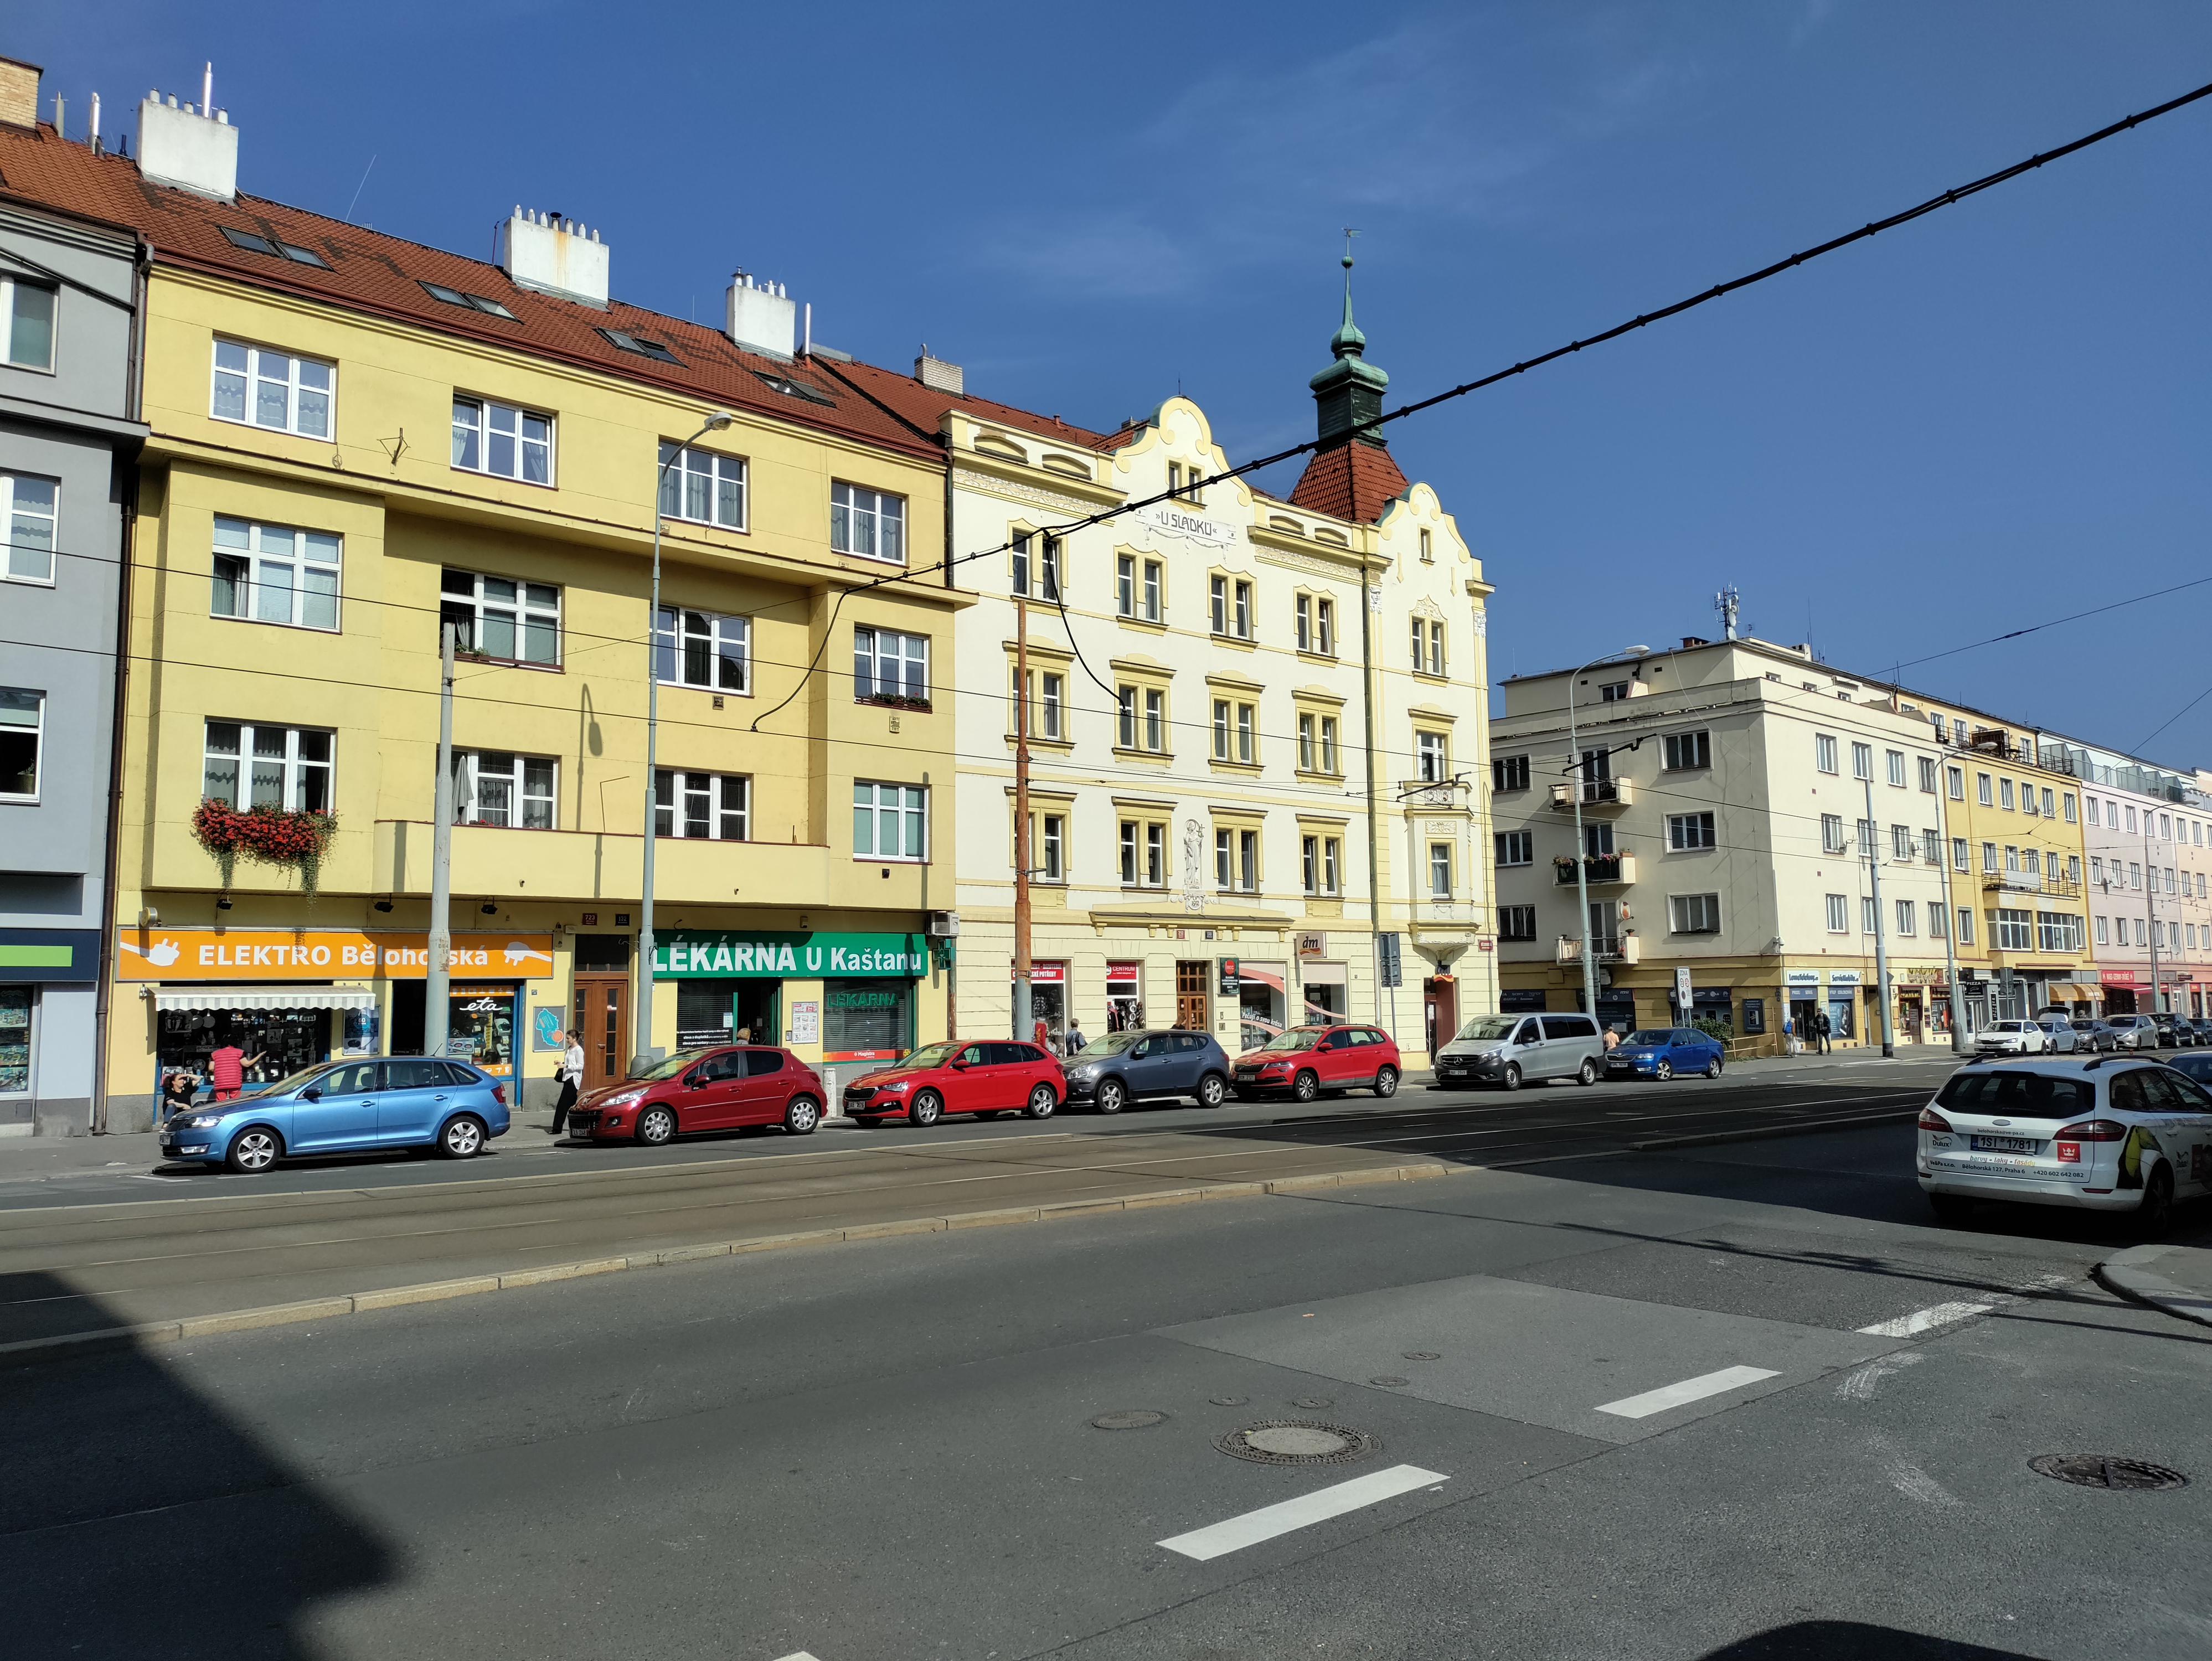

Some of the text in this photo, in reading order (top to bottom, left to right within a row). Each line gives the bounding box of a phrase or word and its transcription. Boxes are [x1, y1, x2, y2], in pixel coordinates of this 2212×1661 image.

[1302, 936, 1318, 948] dm
[199, 943, 488, 966] ELEKTRO Bělohoská
[653, 935, 921, 971] LÉKÁRNA U Kaštanu
[459, 997, 503, 1011] eta
[1271, 1019, 1283, 1028] krásu
[1980, 1137, 2031, 1150] 1SI 1781
[1969, 1155, 1988, 1163] barvy
[2014, 1158, 2036, 1167] fasády
